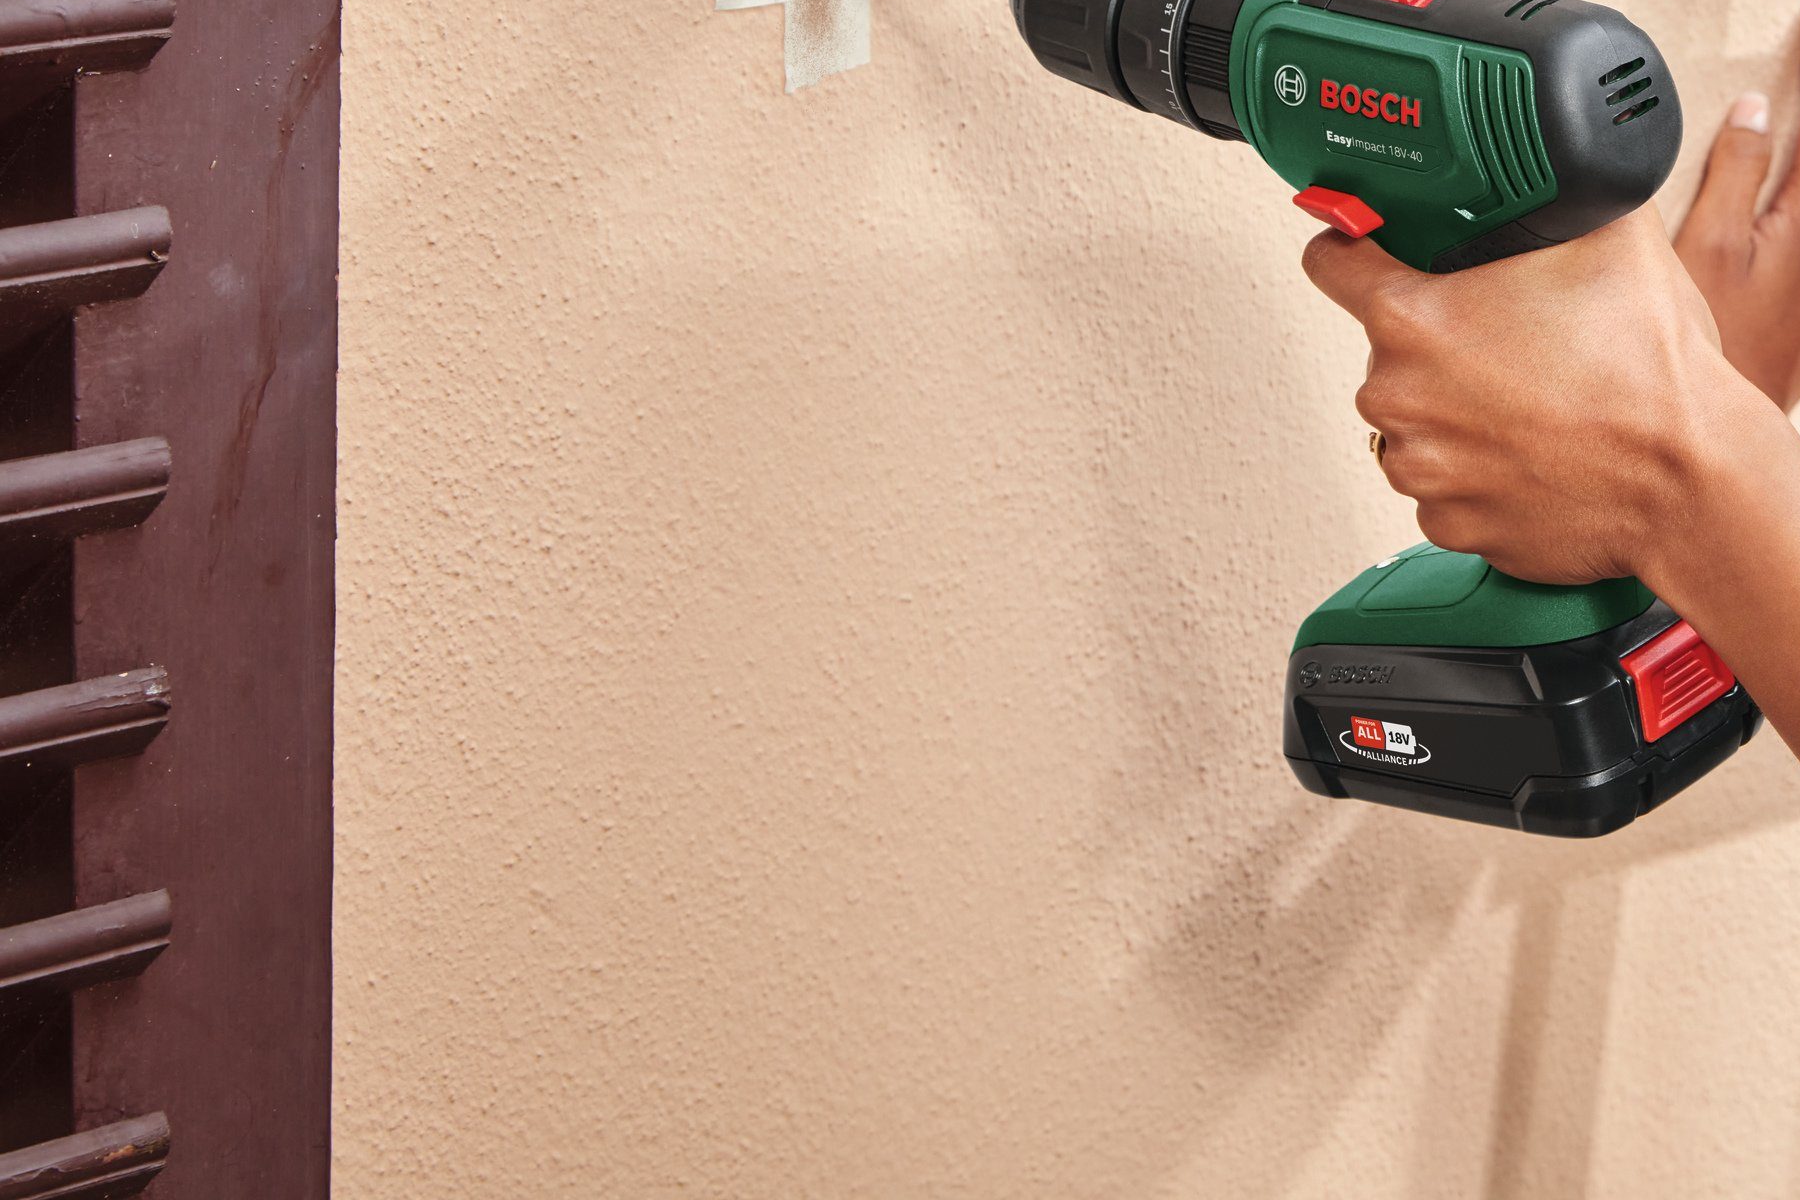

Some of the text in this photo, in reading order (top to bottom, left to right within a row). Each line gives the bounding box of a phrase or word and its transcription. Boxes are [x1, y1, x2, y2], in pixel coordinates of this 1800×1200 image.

[1164, 2, 1173, 16] 15
[1320, 79, 1421, 128] BOSCH
[1326, 130, 1423, 163] EasyImpact 18V-40
[1328, 665, 1396, 685] BOSCH
[1358, 725, 1382, 741] ALL
[1388, 731, 1410, 746] 18V
[1366, 751, 1408, 766] ALLIANCE
